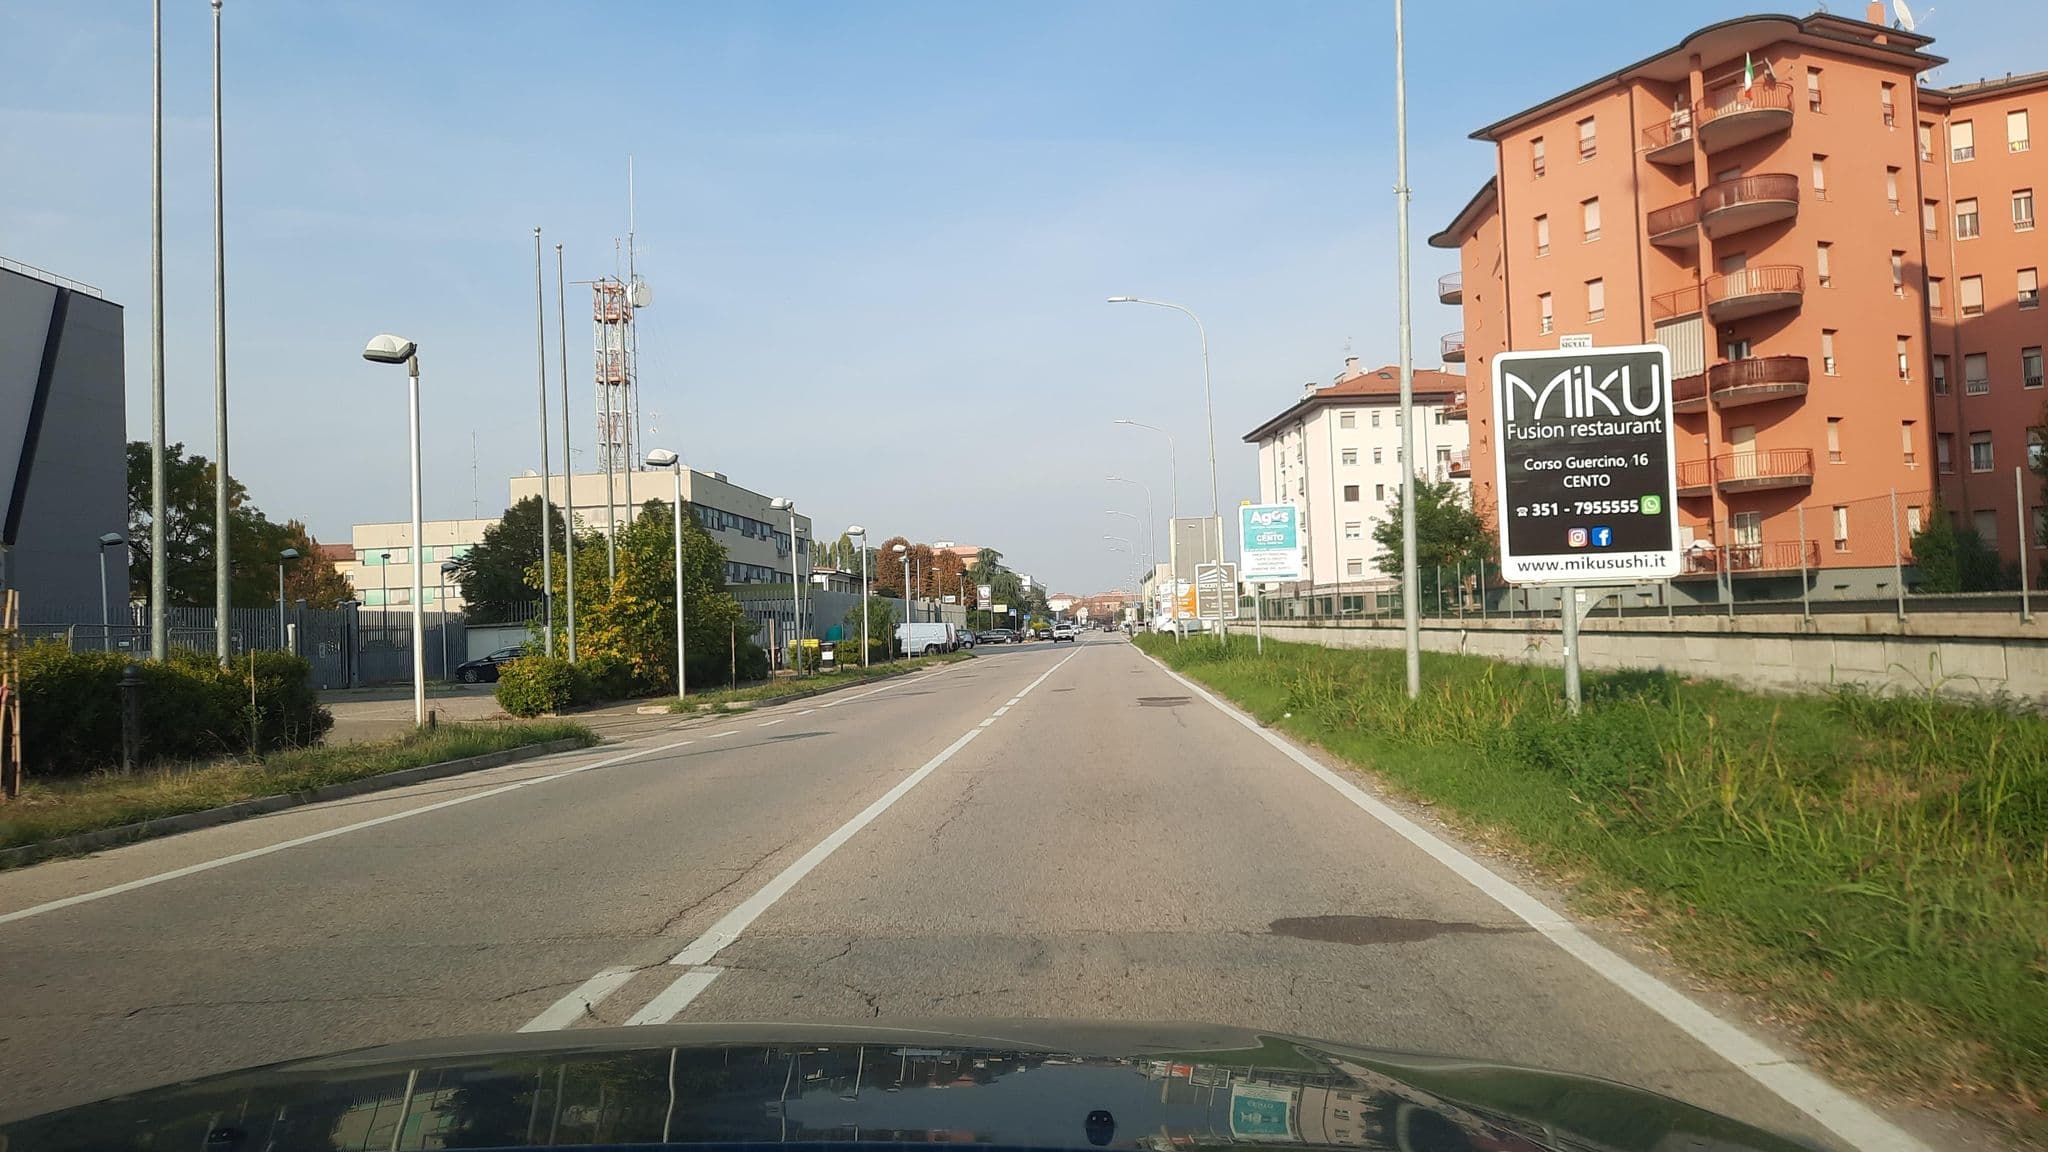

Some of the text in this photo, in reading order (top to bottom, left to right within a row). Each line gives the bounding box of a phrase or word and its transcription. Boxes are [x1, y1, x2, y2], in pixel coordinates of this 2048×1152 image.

[1507, 418, 1662, 440] Fusion restaurant
[1524, 453, 1648, 471] Corso Guercino, 16
[1563, 475, 1610, 488] CENTO
[1532, 503, 1558, 516] 351
[1575, 500, 1639, 515] 7955555
[1250, 511, 1289, 525] Agos
[1256, 534, 1284, 542] CENTO
[1518, 554, 1666, 571] www.mikusushi.it
